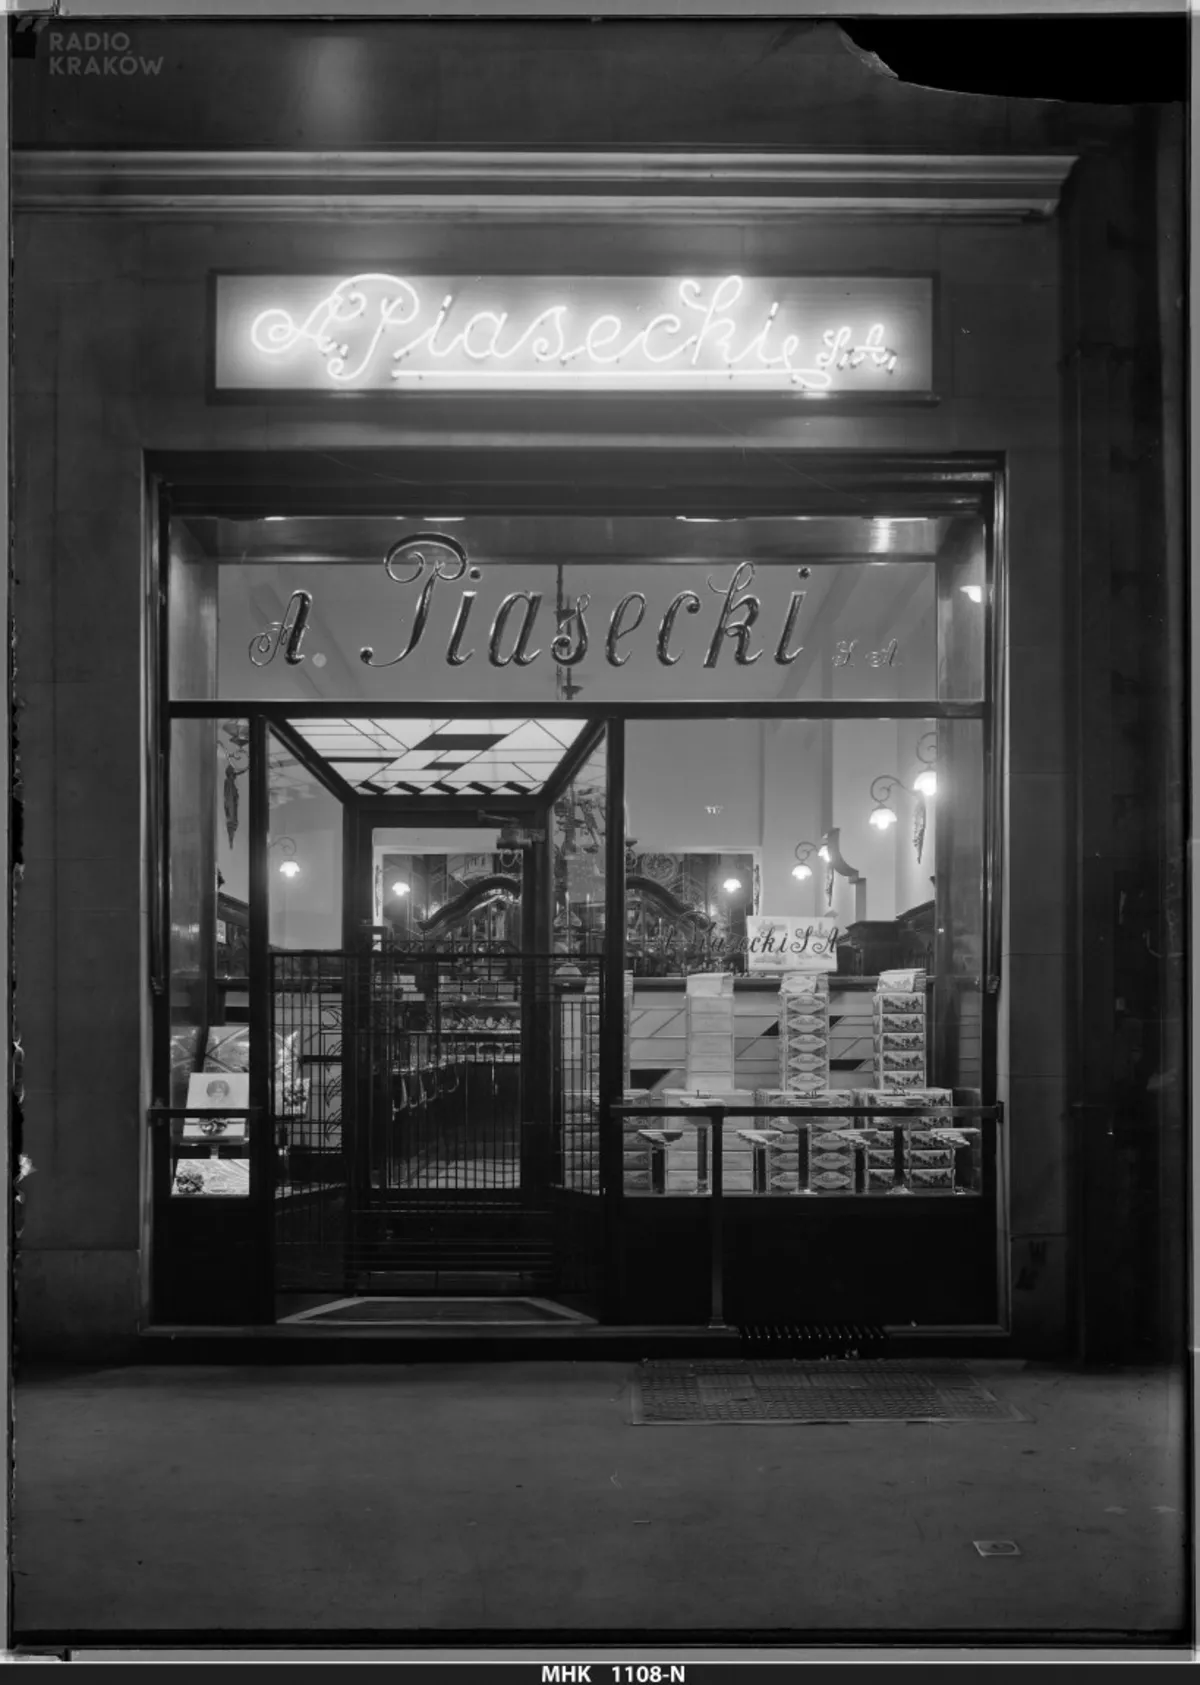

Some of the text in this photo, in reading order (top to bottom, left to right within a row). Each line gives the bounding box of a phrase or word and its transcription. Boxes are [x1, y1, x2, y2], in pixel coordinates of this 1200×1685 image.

[326, 272, 832, 388] Piasecki
[249, 589, 313, 666] A
[359, 531, 815, 668] Piasecki
